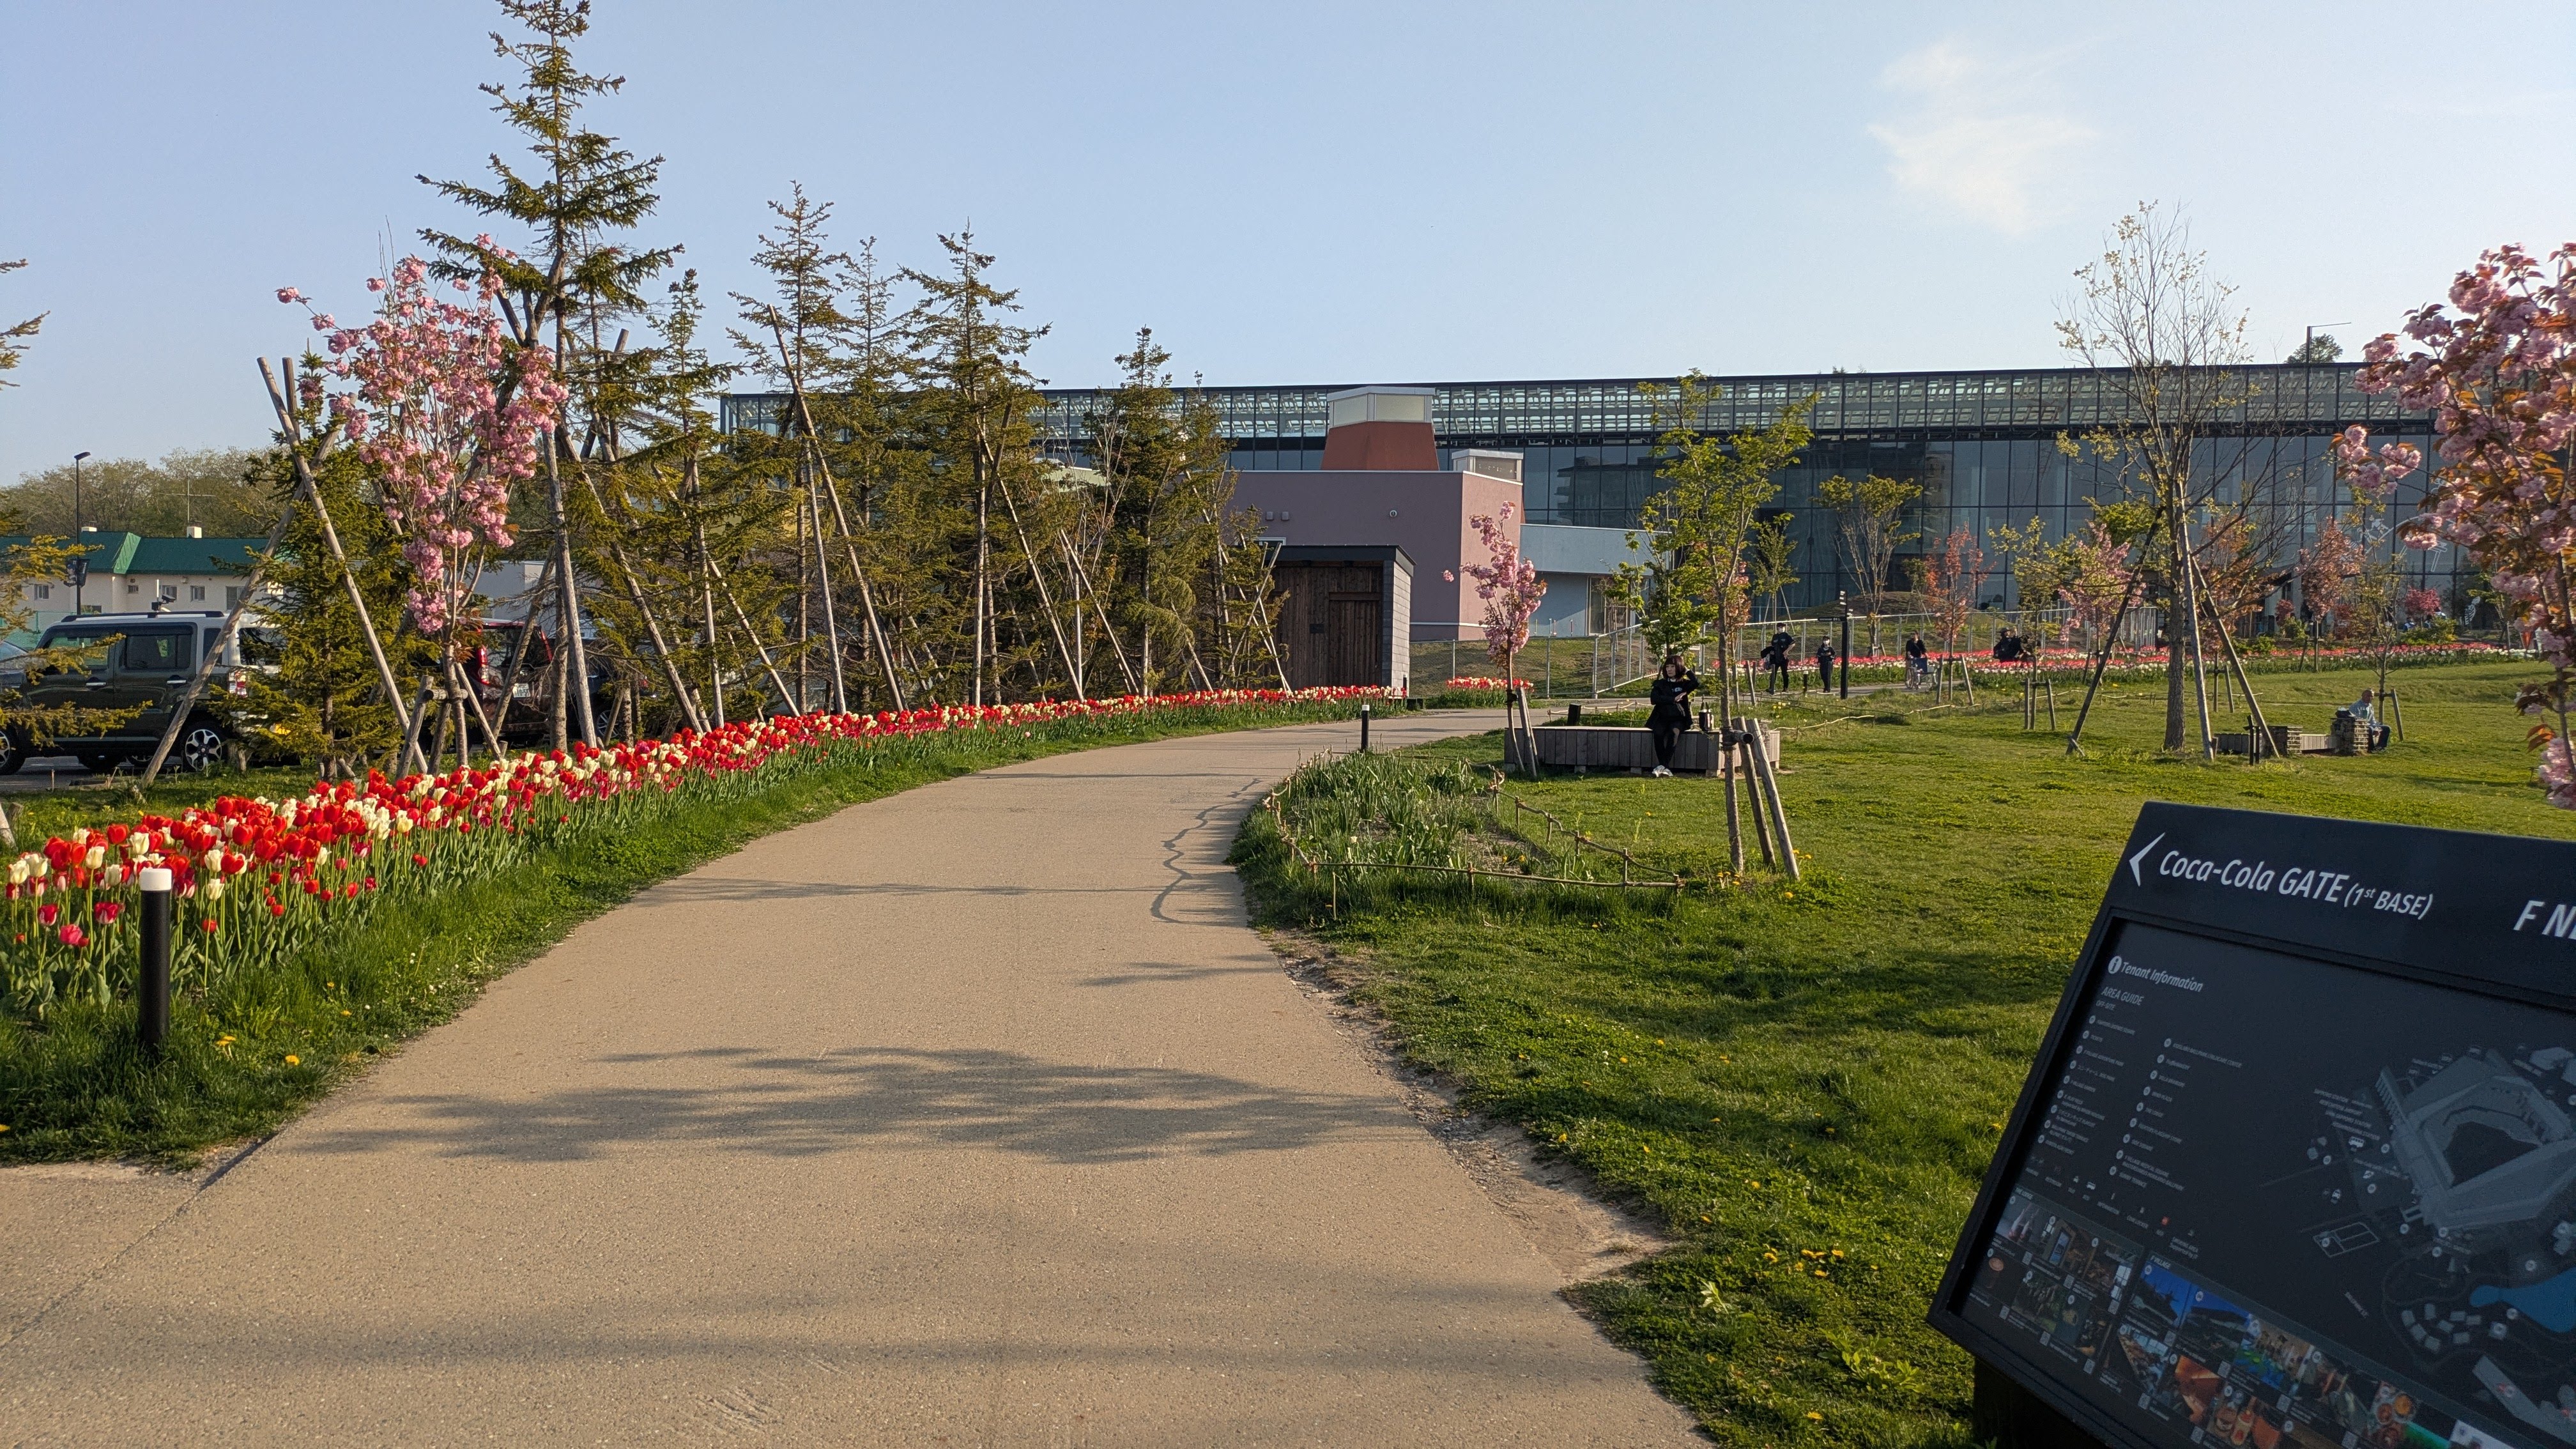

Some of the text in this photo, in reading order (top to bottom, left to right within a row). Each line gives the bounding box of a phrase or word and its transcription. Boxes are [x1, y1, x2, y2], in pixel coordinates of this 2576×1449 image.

[2160, 850, 2275, 891] Coca-Cola
[2279, 868, 2350, 903] GATE
[2374, 891, 2434, 920] BASE)
[2513, 900, 2576, 940] F N
[2120, 962, 2204, 992] Tenant Information
[2101, 986, 2145, 1006] AREA GUIDE
